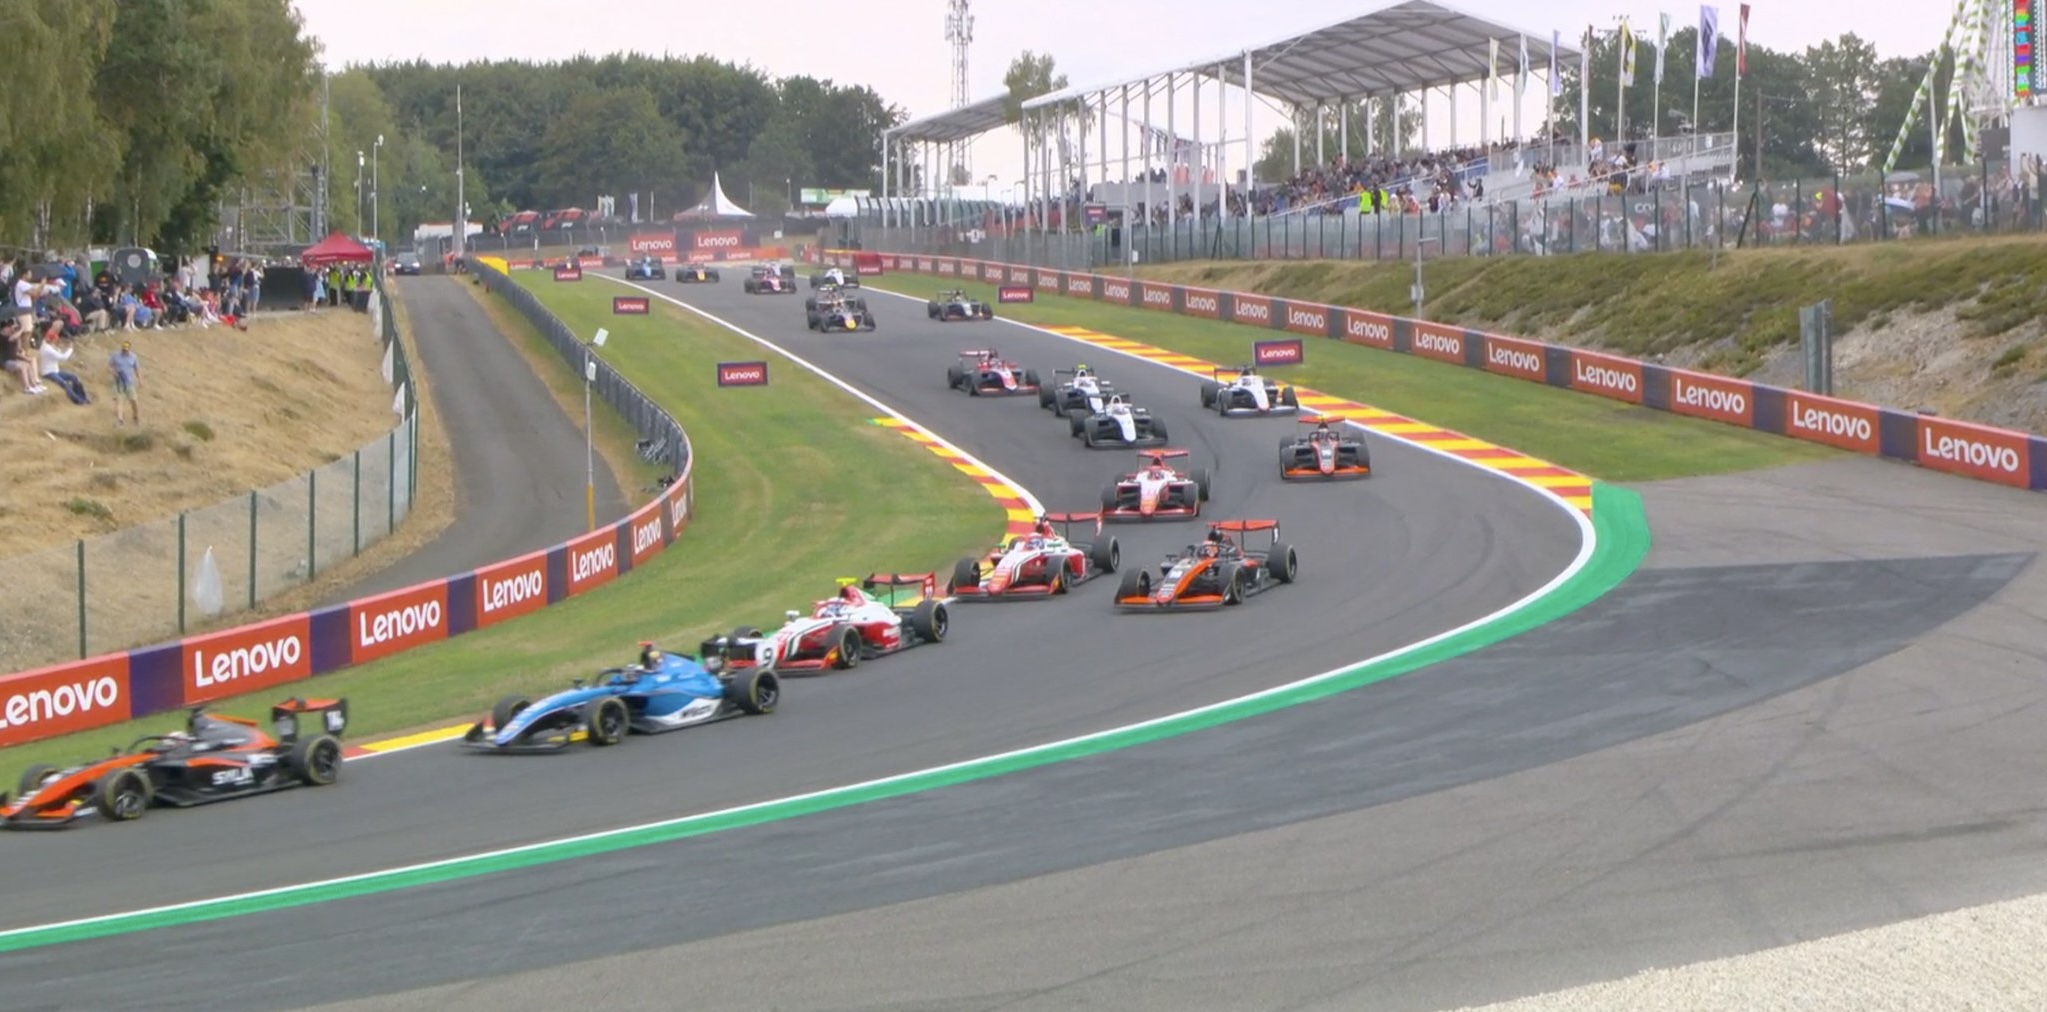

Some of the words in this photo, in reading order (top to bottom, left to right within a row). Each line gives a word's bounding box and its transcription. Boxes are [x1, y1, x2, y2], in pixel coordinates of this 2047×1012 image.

[632, 238, 673, 251] Lenovo
[697, 235, 738, 248] Lenovo
[1003, 291, 1029, 299] Lenovo
[1068, 276, 1092, 293] Lenovo
[1103, 280, 1129, 299] Lenovo
[1143, 285, 1171, 307] Lenovo
[617, 301, 646, 311] Lenovo
[1185, 290, 1217, 313] Lenovo
[1235, 296, 1269, 320] Lenovo
[1288, 305, 1325, 329] Lenovo
[1347, 315, 1389, 341] Lenovo
[1261, 348, 1296, 359] Lenovo
[1415, 328, 1460, 355] Lenovo
[1488, 342, 1540, 373] Lenovo
[724, 368, 761, 380] Lenovo
[1576, 359, 1637, 393] Lenovo
[1676, 379, 1745, 415] Lenovo
[1793, 400, 1871, 440] Lenovo
[1925, 427, 2019, 473] Lenovo
[671, 493, 687, 529] Lenovo
[633, 516, 662, 555] Lenovo
[572, 541, 614, 582] Lenovo
[483, 569, 543, 612] Lenovo
[359, 599, 441, 647] Lenovo
[195, 635, 301, 688] Lenovo
